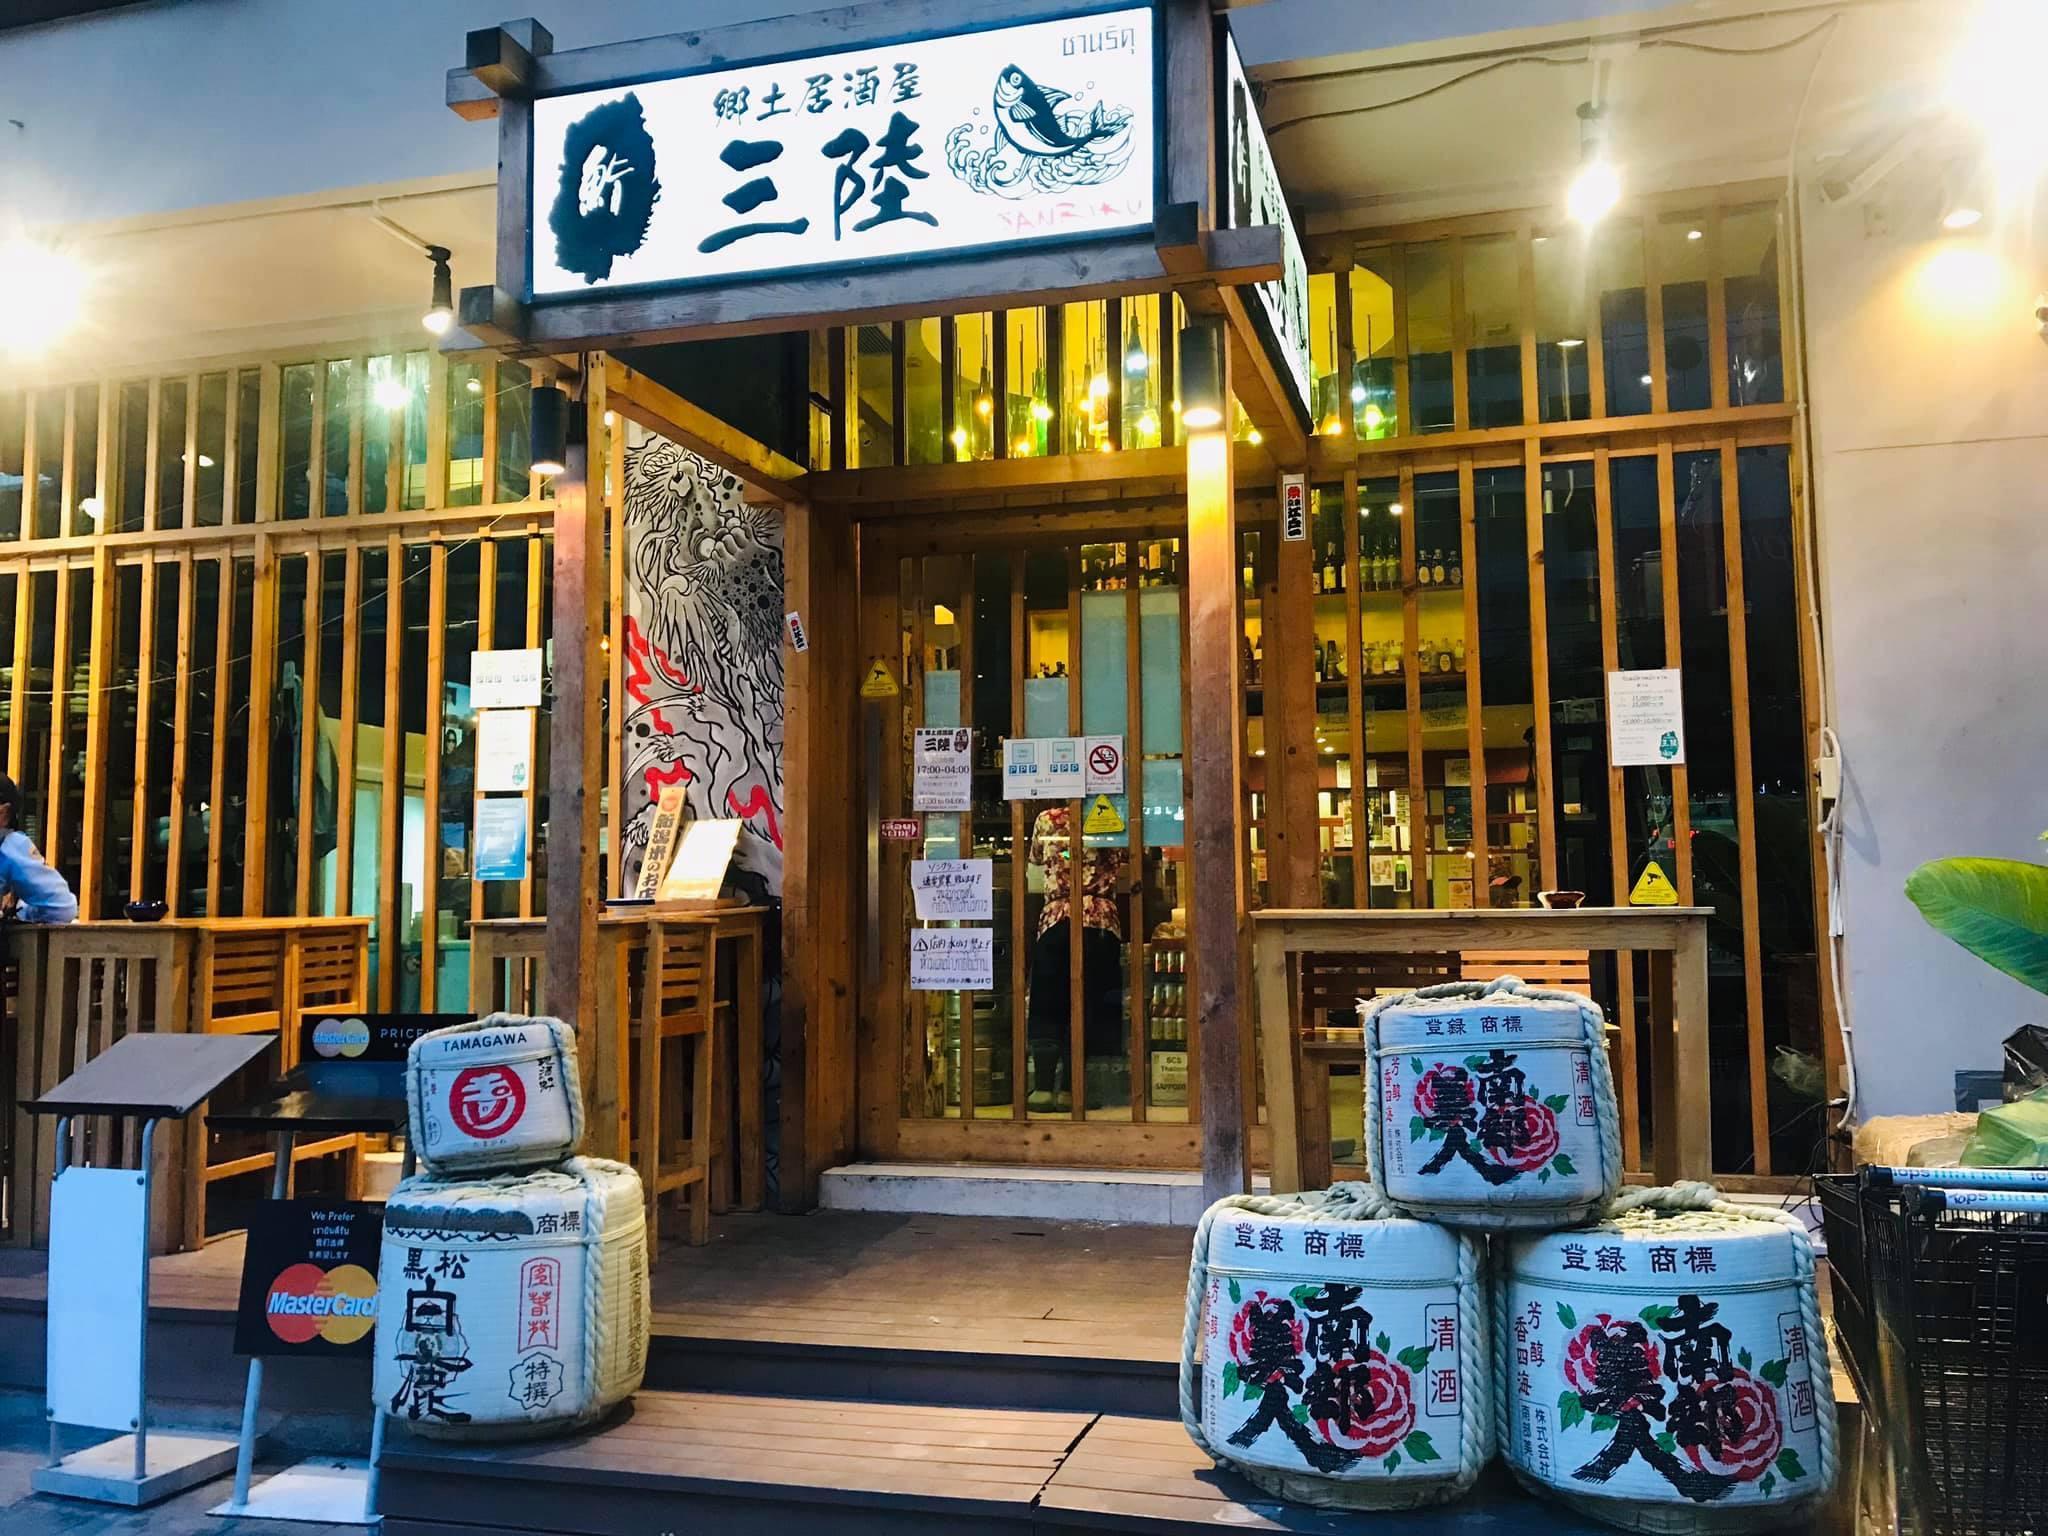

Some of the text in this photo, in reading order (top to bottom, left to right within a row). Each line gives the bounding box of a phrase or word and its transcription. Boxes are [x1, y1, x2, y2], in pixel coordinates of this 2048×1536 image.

[713, 62, 923, 128] 郷土居酒屋
[697, 110, 939, 253] 三陸
[442, 1032, 528, 1053] TAMAGAWA
[1425, 1015, 1523, 1036] 登録商標
[1574, 1059, 1594, 1118] 清酒
[311, 1211, 355, 1221] We Prefer
[535, 1210, 581, 1235] 商標
[1234, 1221, 1366, 1260] 登録商標
[1561, 1242, 1717, 1274] 登録商標
[403, 1247, 470, 1280] 黒松
[267, 1291, 379, 1317] MasterCard
[1430, 1315, 1457, 1405] 清酒
[1784, 1324, 1813, 1417] 清酒
[522, 1359, 551, 1402] 特撰
